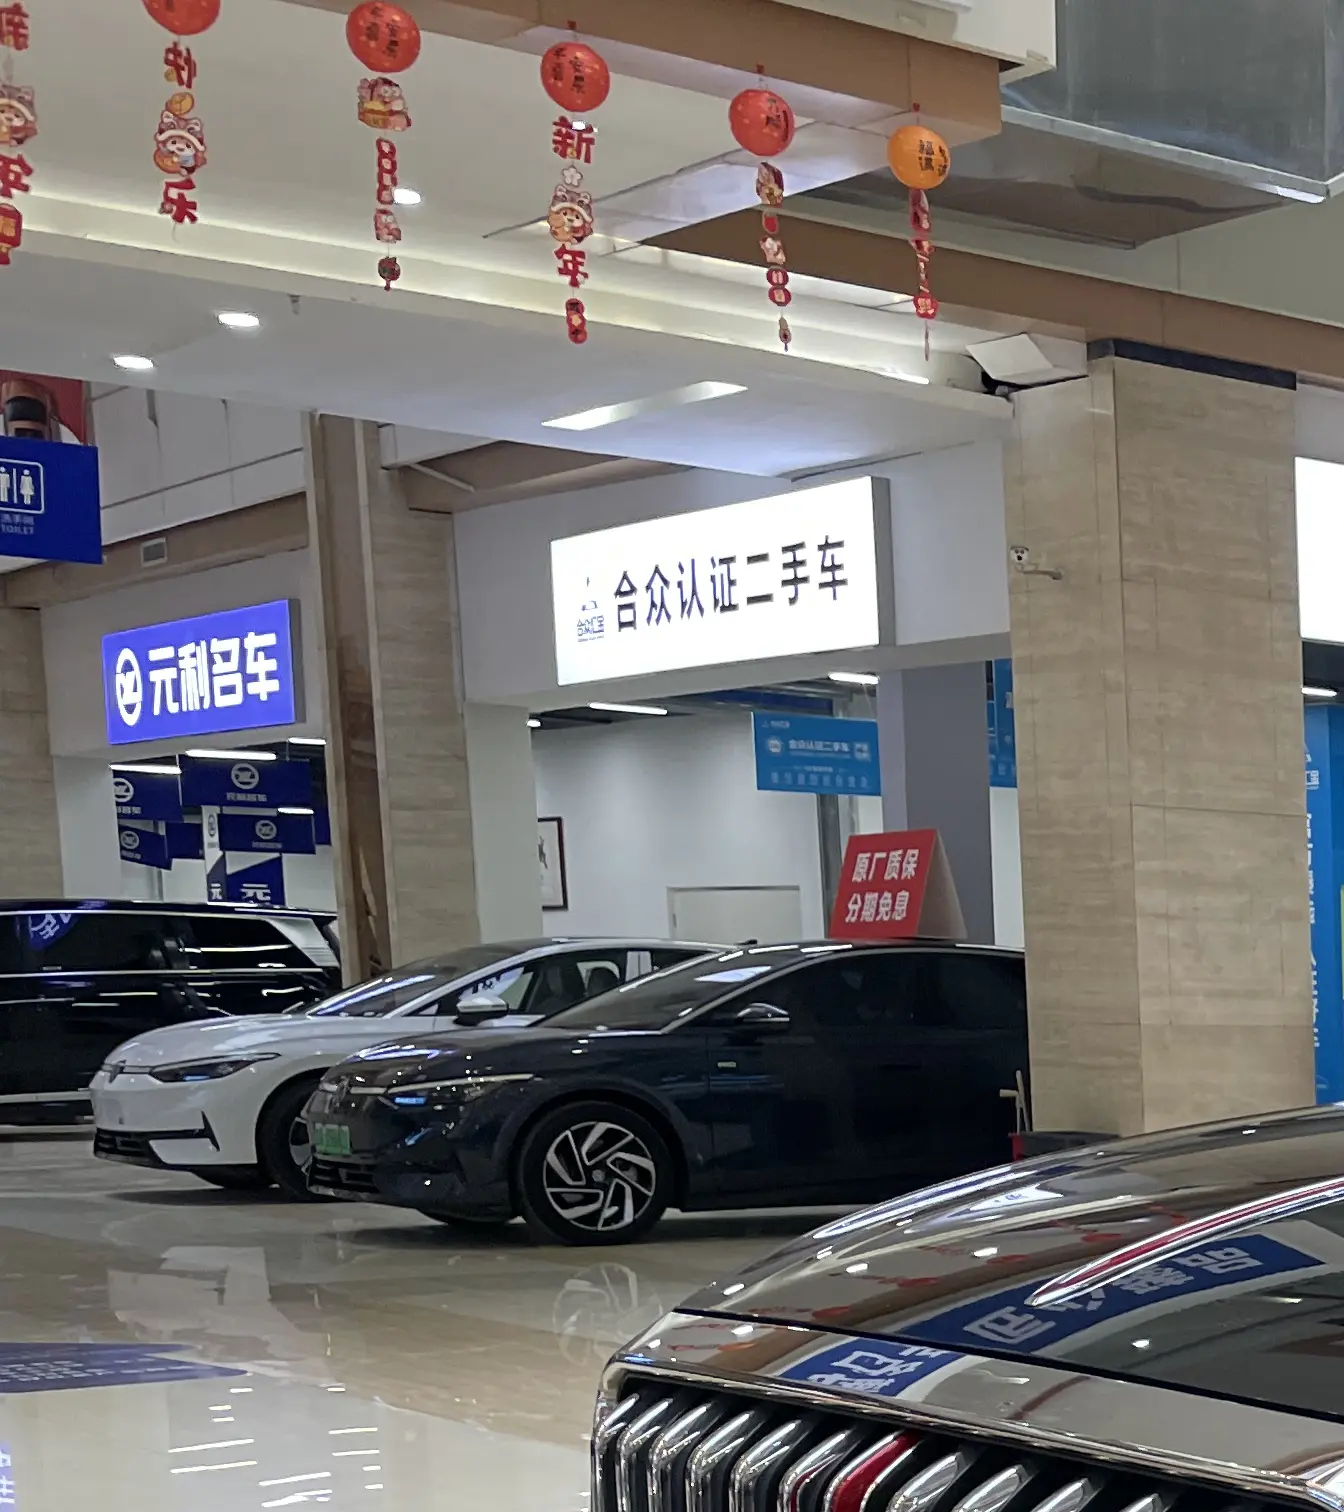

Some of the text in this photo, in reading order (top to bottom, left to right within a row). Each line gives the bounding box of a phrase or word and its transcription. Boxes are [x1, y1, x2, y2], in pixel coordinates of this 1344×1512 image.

[554, 244, 589, 288] 年
[614, 535, 849, 632] 合众认证二手车
[148, 631, 280, 717] 元利名车
[851, 848, 920, 883] 原厂质保
[844, 890, 910, 923] 分期免息
